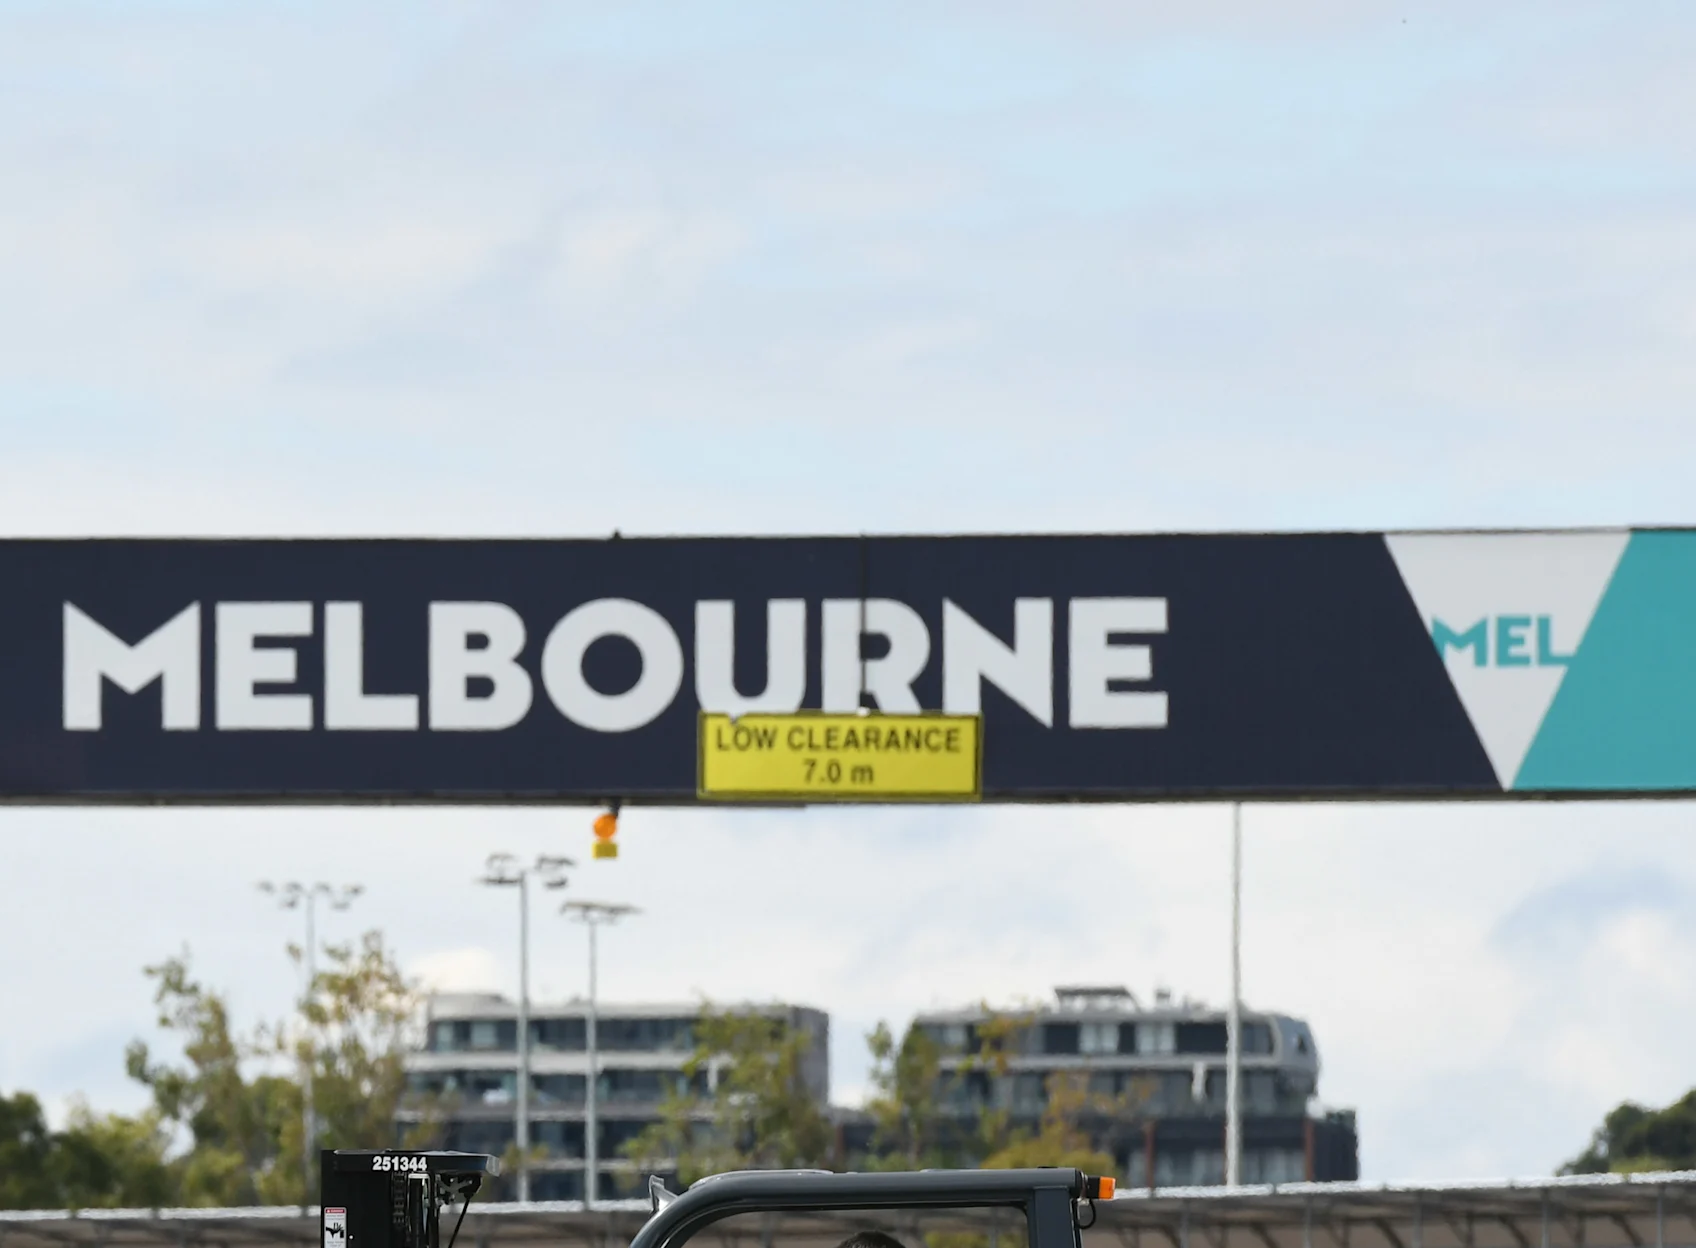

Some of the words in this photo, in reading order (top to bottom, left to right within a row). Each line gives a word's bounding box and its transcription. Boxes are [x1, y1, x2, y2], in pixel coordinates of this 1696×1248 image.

[1430, 614, 1576, 668] MEL
[62, 596, 1169, 733] MELBOURNE
[716, 726, 779, 751] LOW
[787, 726, 962, 752] CLEARANCE
[803, 758, 842, 784] 7.0
[850, 767, 874, 783] m
[372, 1155, 428, 1171] 251344
